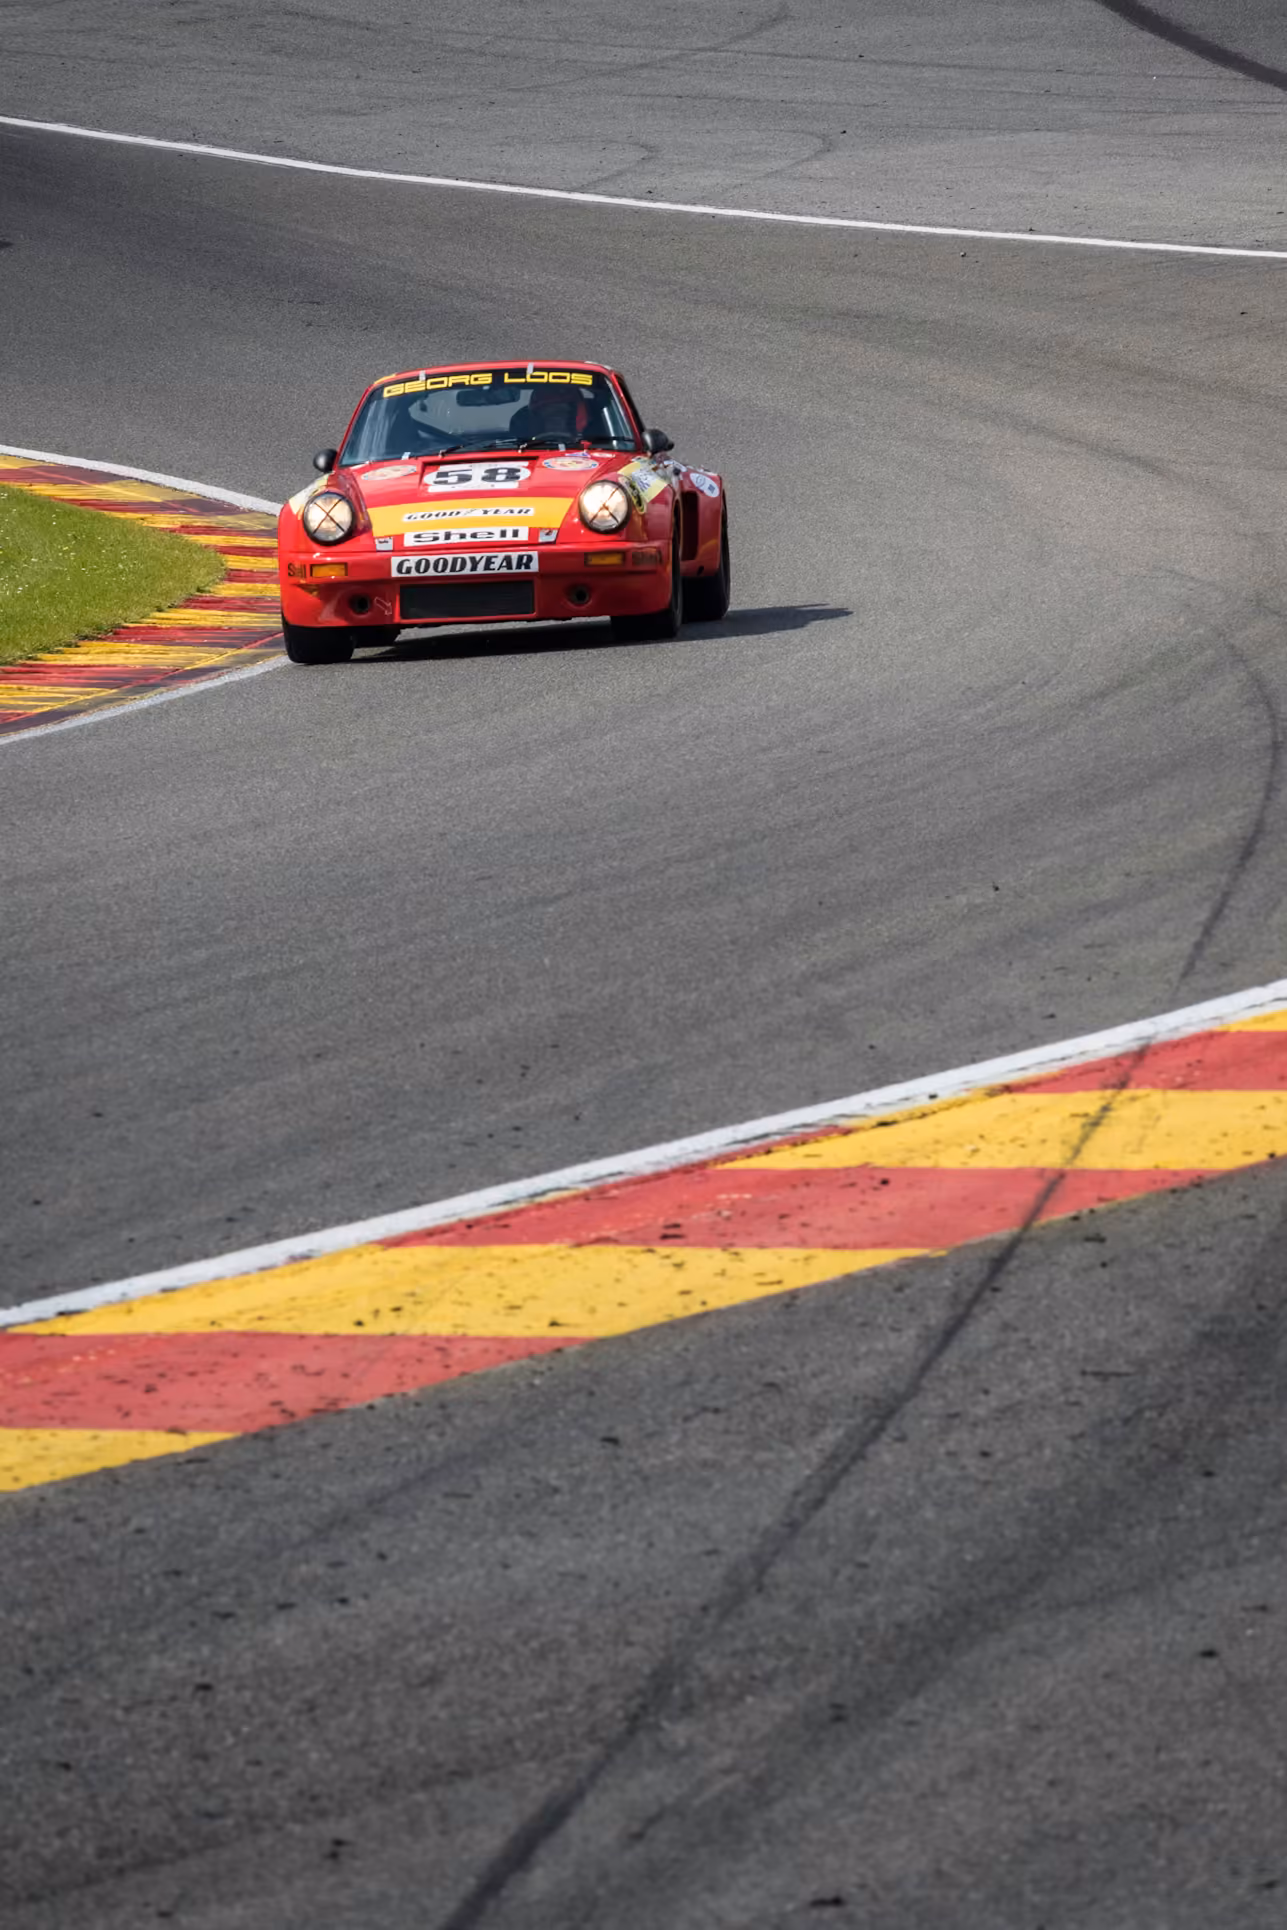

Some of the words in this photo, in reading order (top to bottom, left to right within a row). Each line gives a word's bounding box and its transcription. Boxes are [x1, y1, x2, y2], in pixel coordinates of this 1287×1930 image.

[383, 373, 492, 398] GEORG
[504, 371, 592, 385] LOOS
[433, 467, 521, 485] 58
[413, 529, 520, 543] Shell
[396, 554, 533, 575] GOODYEAR
